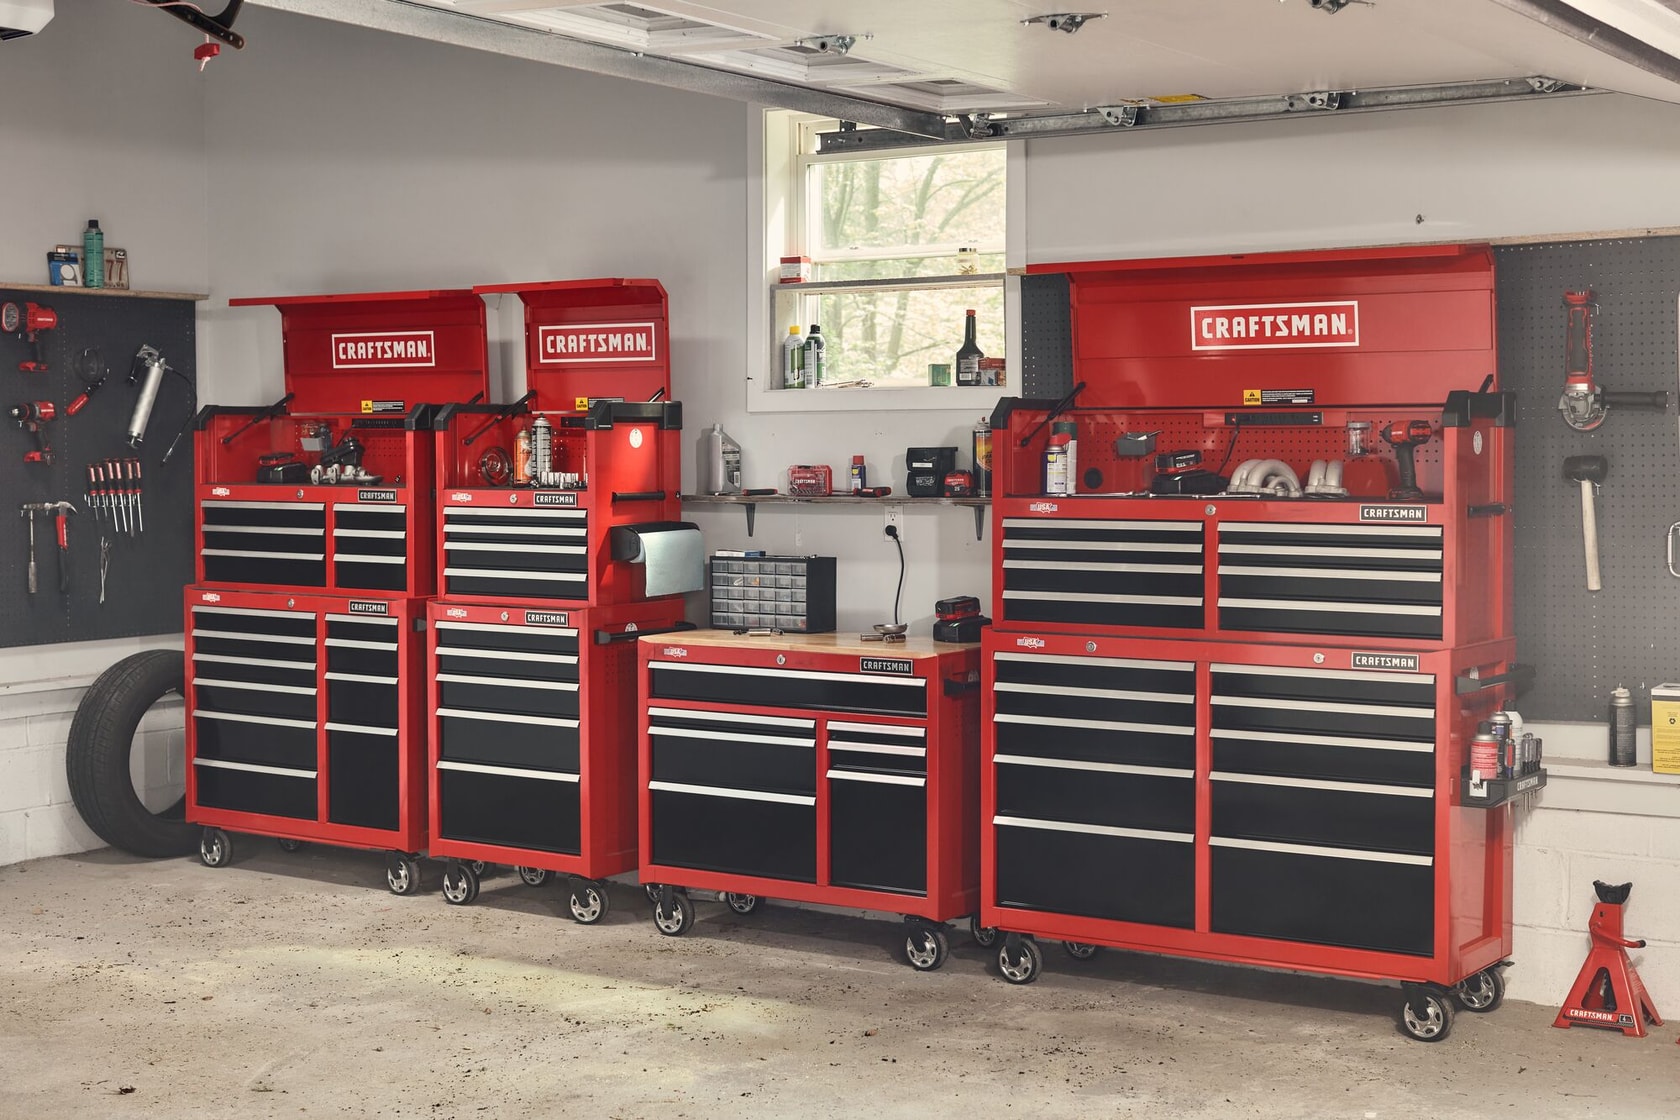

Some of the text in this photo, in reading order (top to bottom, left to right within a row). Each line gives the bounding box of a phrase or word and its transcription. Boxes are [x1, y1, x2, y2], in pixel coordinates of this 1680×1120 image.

[1202, 313, 1346, 339] CRAFTSMAN
[546, 333, 647, 353] CRAFTSMAN
[338, 340, 427, 359] CRAFTSMAN
[360, 492, 394, 500] CRAFTSMAN
[536, 495, 574, 503] CRAFTSMAN
[1364, 508, 1422, 518] CRAFTSMAN
[351, 603, 386, 612] CRAFTSMAN
[527, 613, 566, 623] CRAFTSMAN
[863, 660, 910, 671] CRAFTSMAN
[1355, 656, 1415, 667] CRAFTSMAN
[1569, 1009, 1613, 1021] CRAFTSMAN
